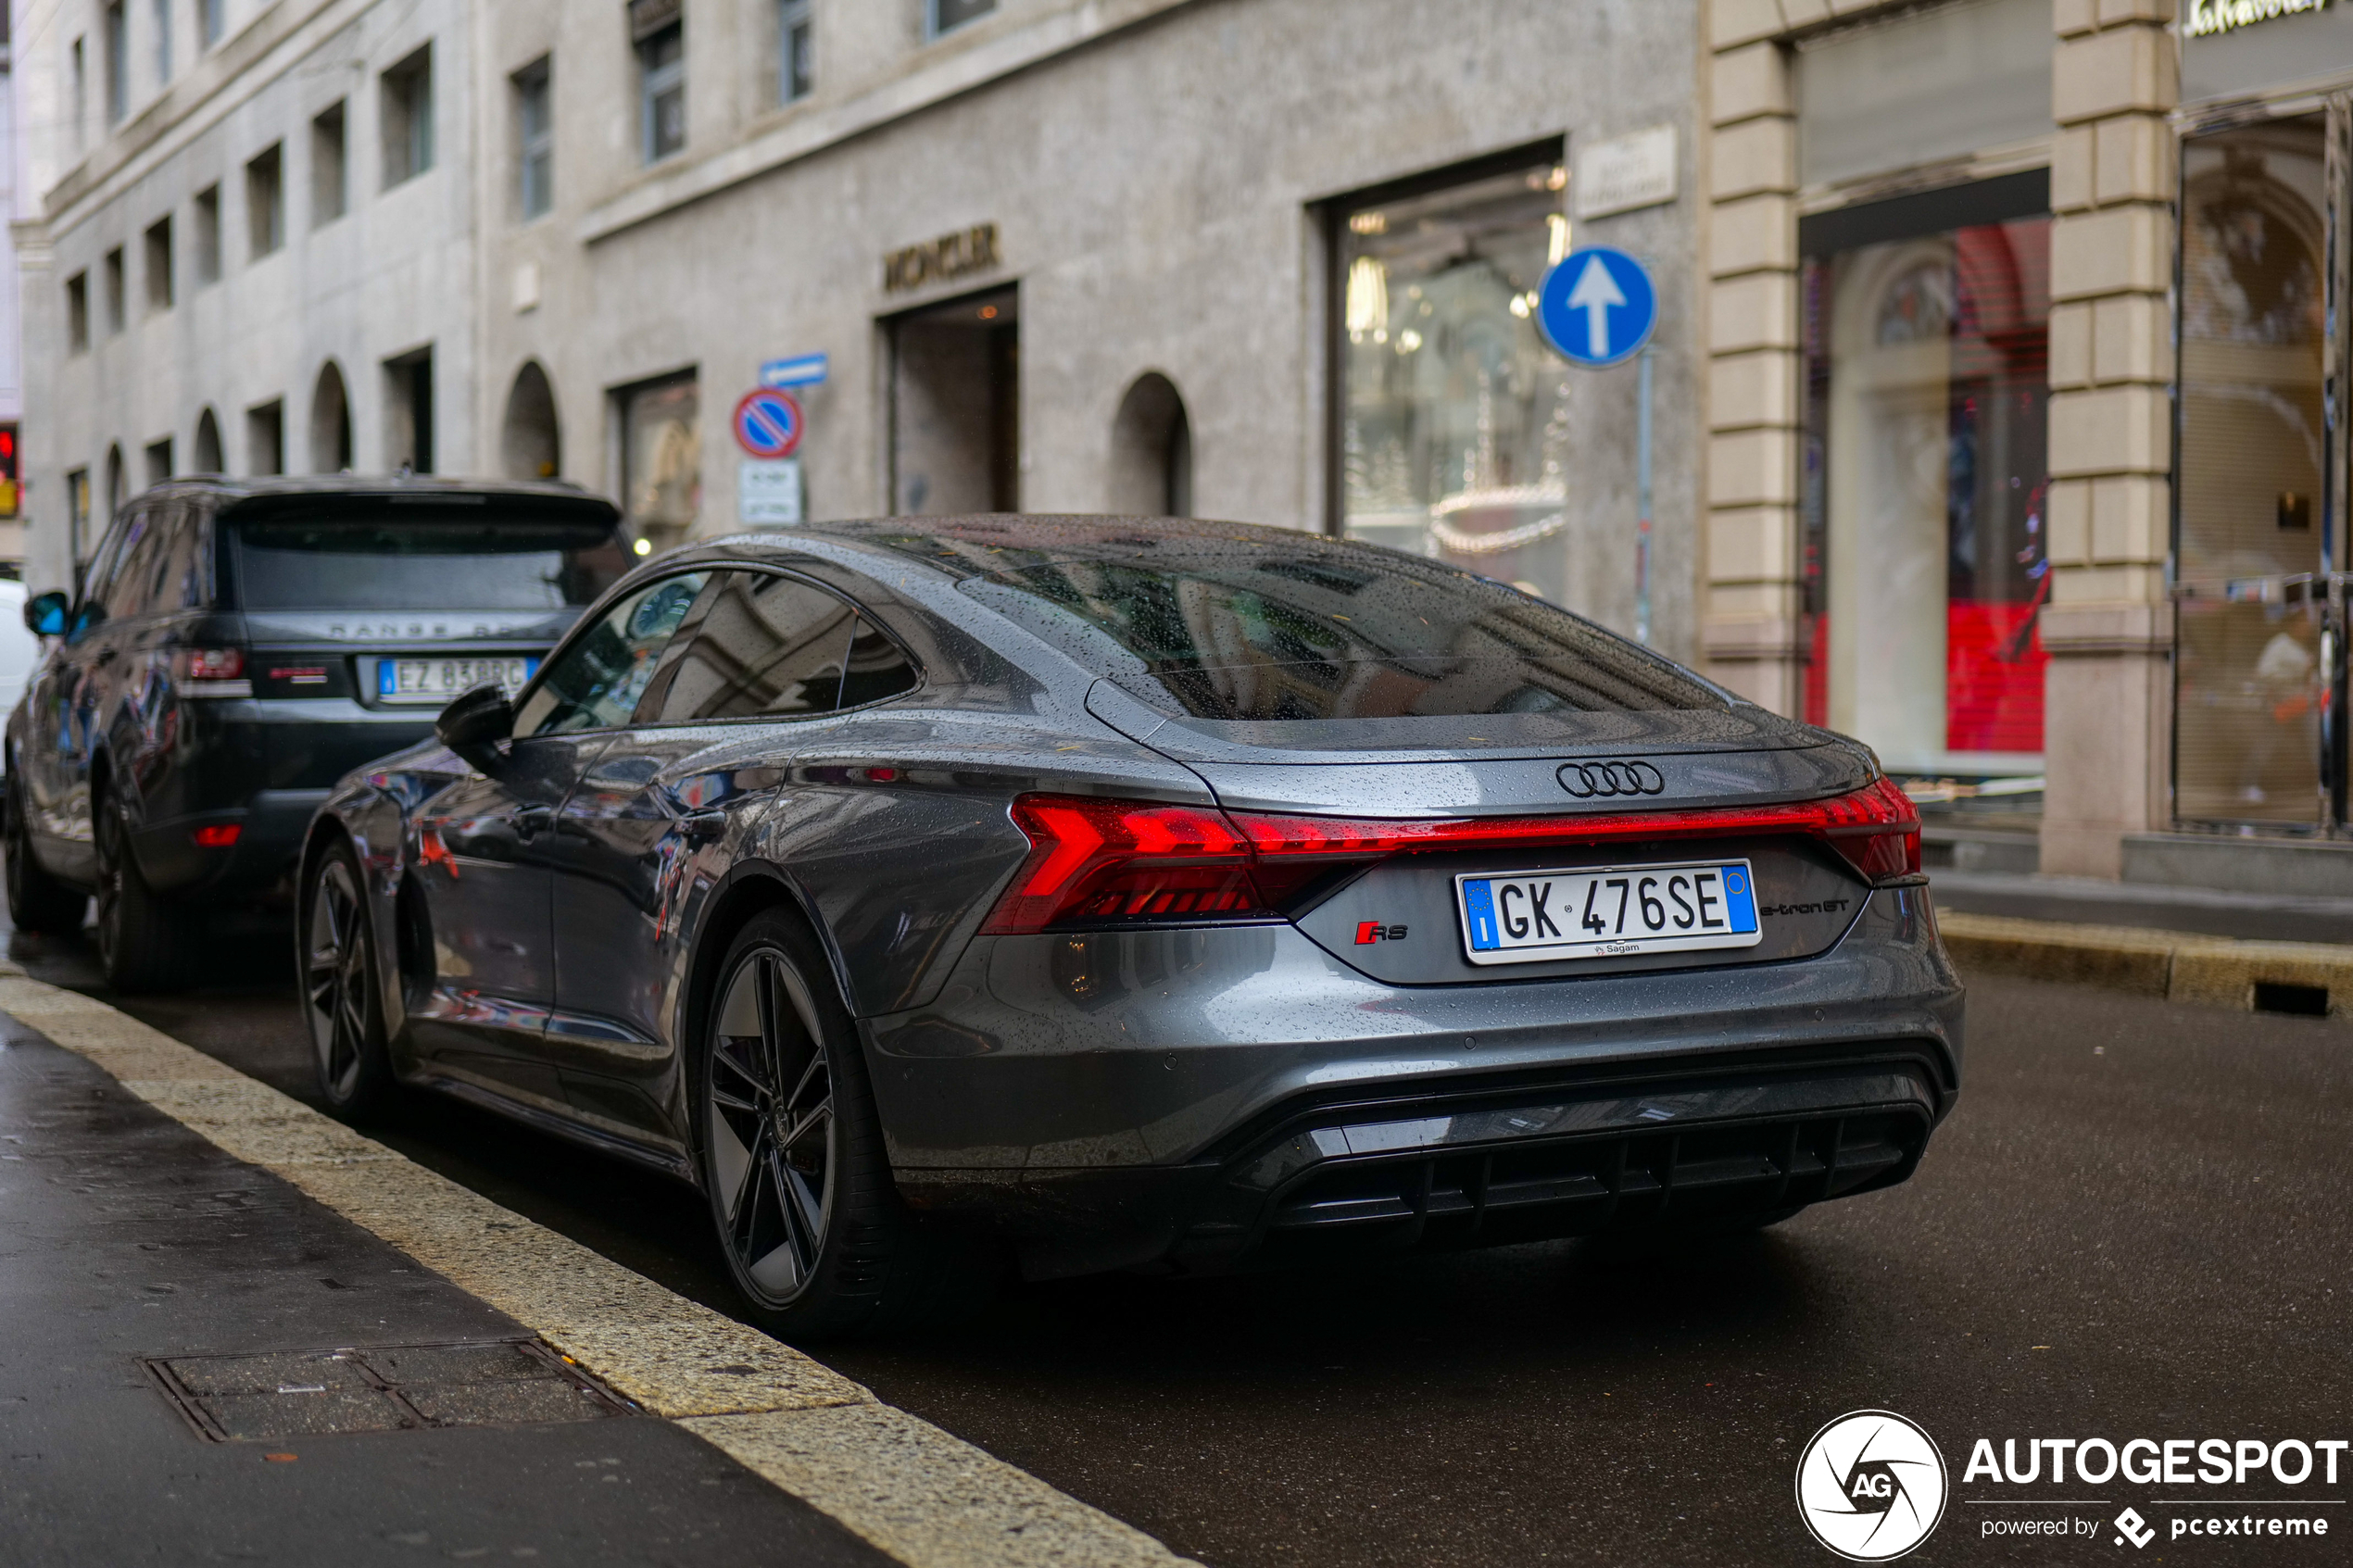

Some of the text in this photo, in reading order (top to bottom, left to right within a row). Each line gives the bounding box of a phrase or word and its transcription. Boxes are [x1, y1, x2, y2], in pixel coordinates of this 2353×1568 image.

[885, 220, 1000, 292] MONCLER
[330, 623, 447, 637] RANGE
[1500, 882, 1562, 939] GK
[1581, 873, 1724, 935] 476SE
[1606, 945, 1640, 954] Sagam
